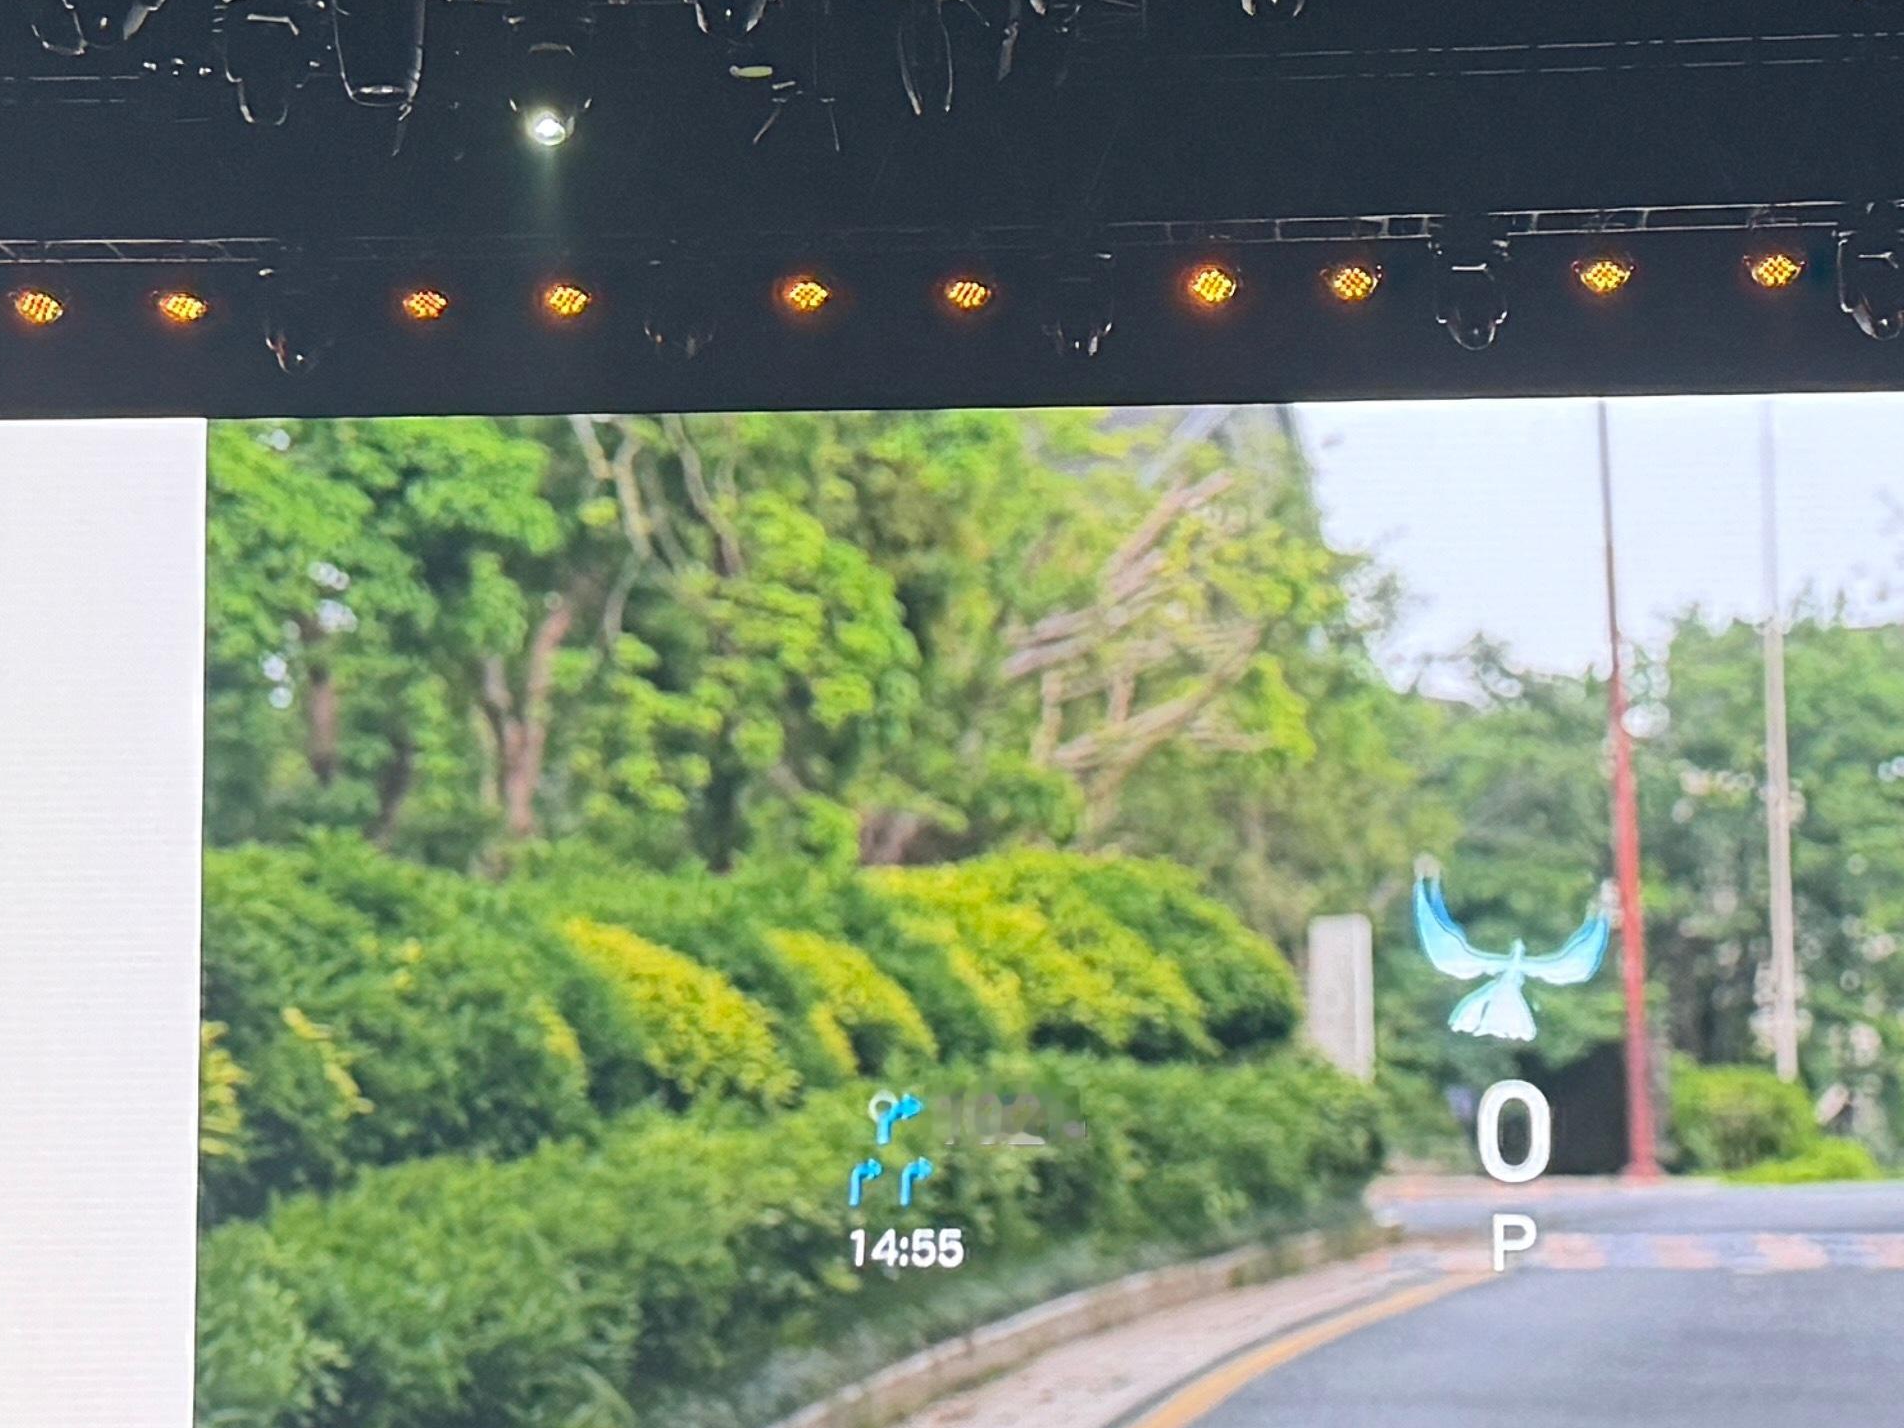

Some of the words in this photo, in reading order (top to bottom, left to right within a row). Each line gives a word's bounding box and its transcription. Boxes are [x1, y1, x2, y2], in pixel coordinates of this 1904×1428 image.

[1477, 1079, 1550, 1182] 0
[849, 1228, 965, 1268] 14:55
[1492, 1213, 1536, 1271] P
